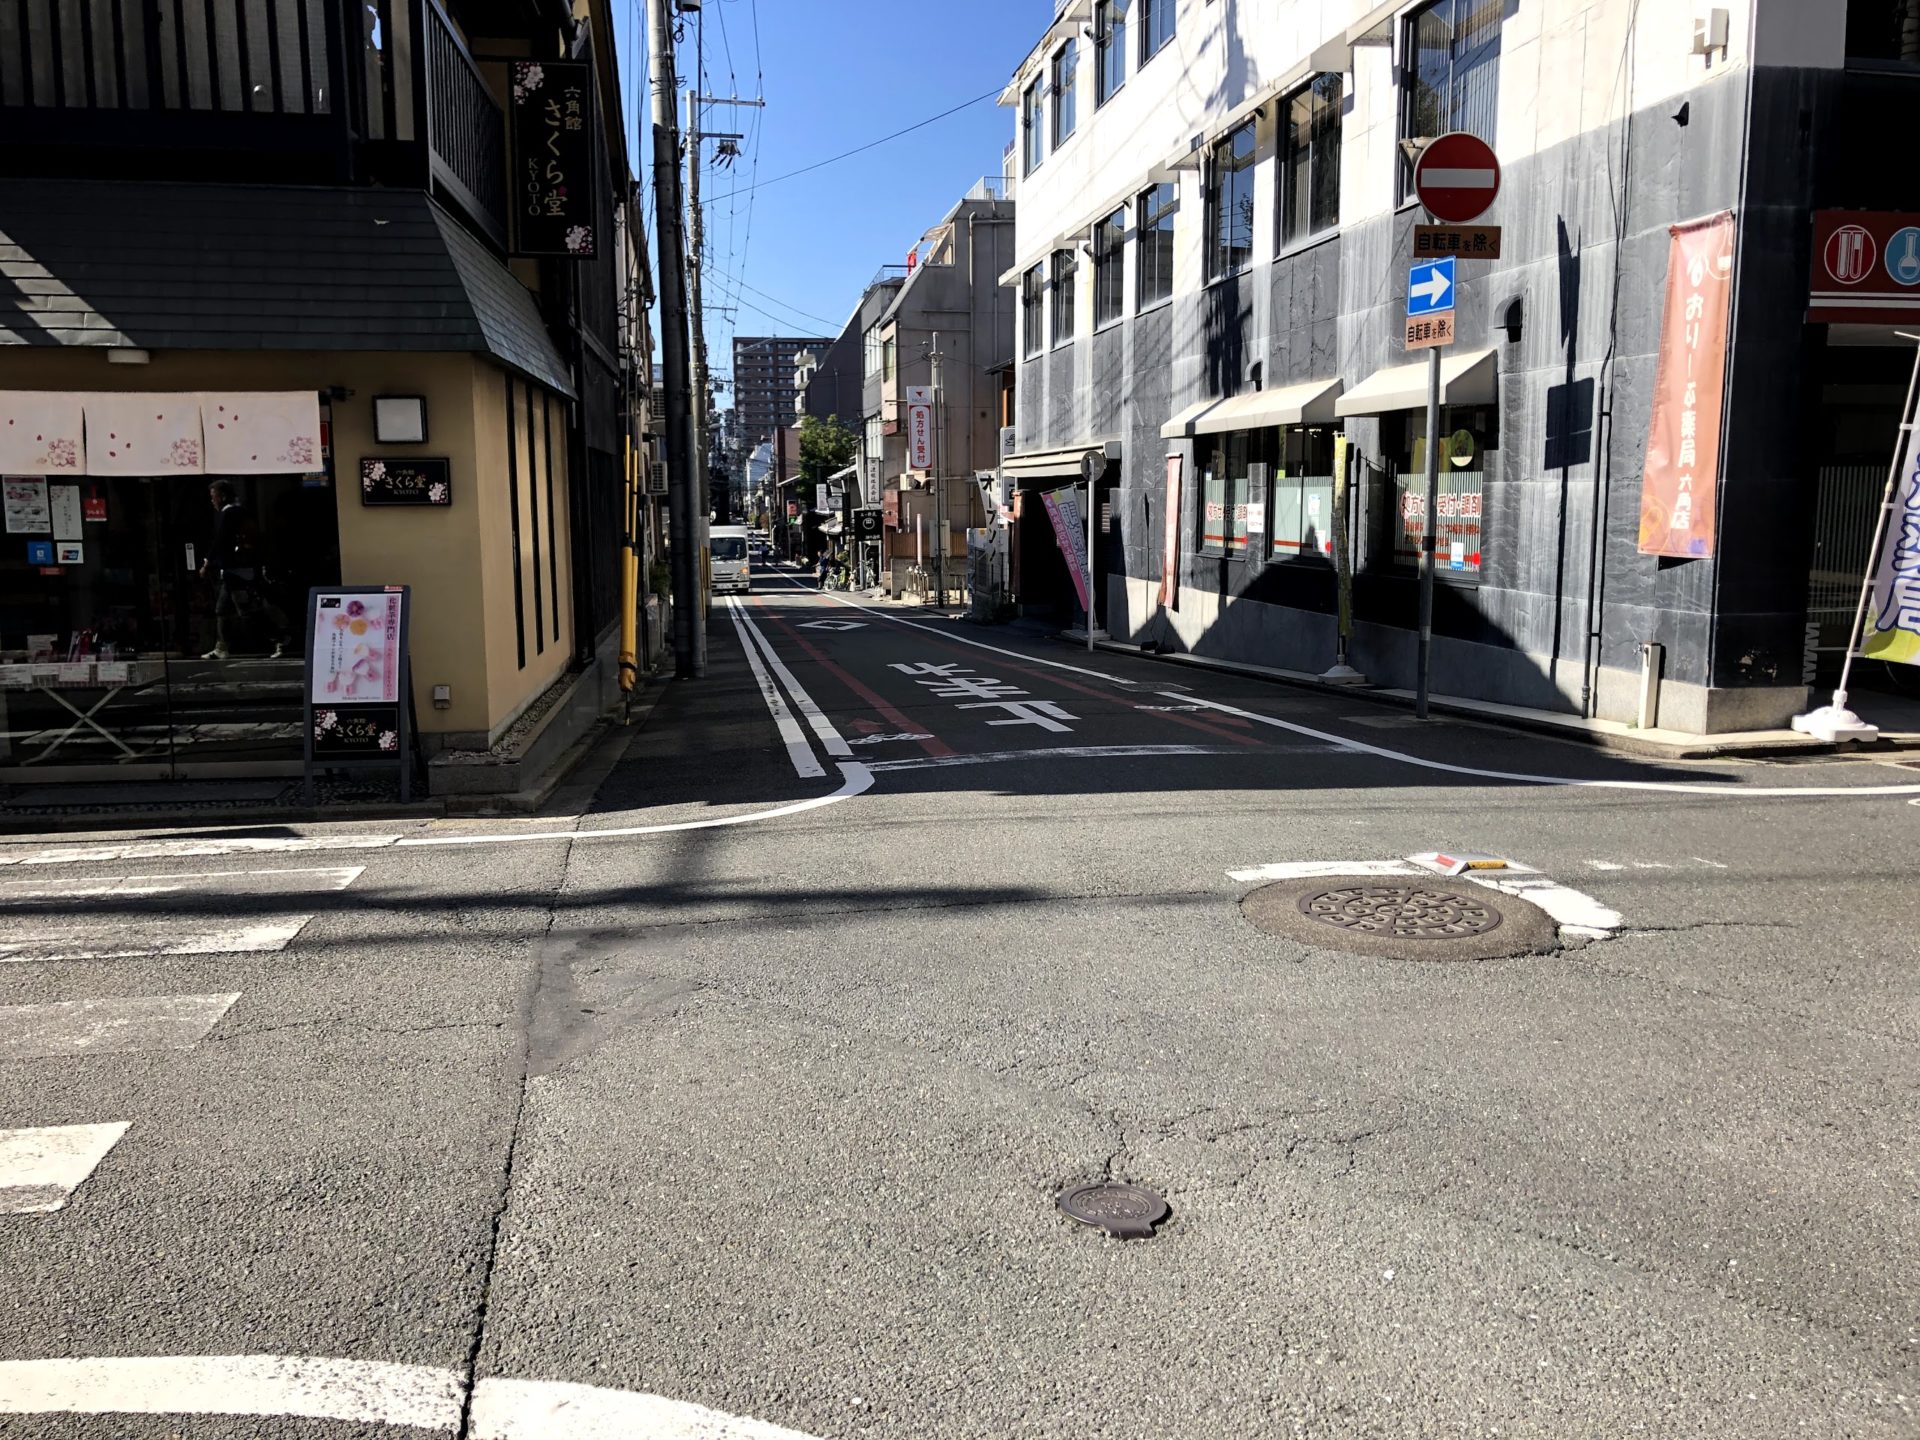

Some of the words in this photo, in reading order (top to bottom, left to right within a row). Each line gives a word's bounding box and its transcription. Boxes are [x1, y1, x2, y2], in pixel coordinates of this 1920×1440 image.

[564, 86, 583, 130] 六角館
[544, 99, 568, 216] さくら堂
[528, 158, 540, 216] KYOTO
[1417, 232, 1497, 252] 自転車を除く
[1407, 319, 1452, 343] 自転車を除く
[1677, 296, 1704, 468] おりーぶ薬局
[916, 410, 926, 464] 処方せん受付
[385, 474, 426, 489] さくら堂
[1670, 474, 1693, 529] 六角店
[887, 662, 1082, 731] 止まれ
[336, 723, 376, 738] さくら堂
